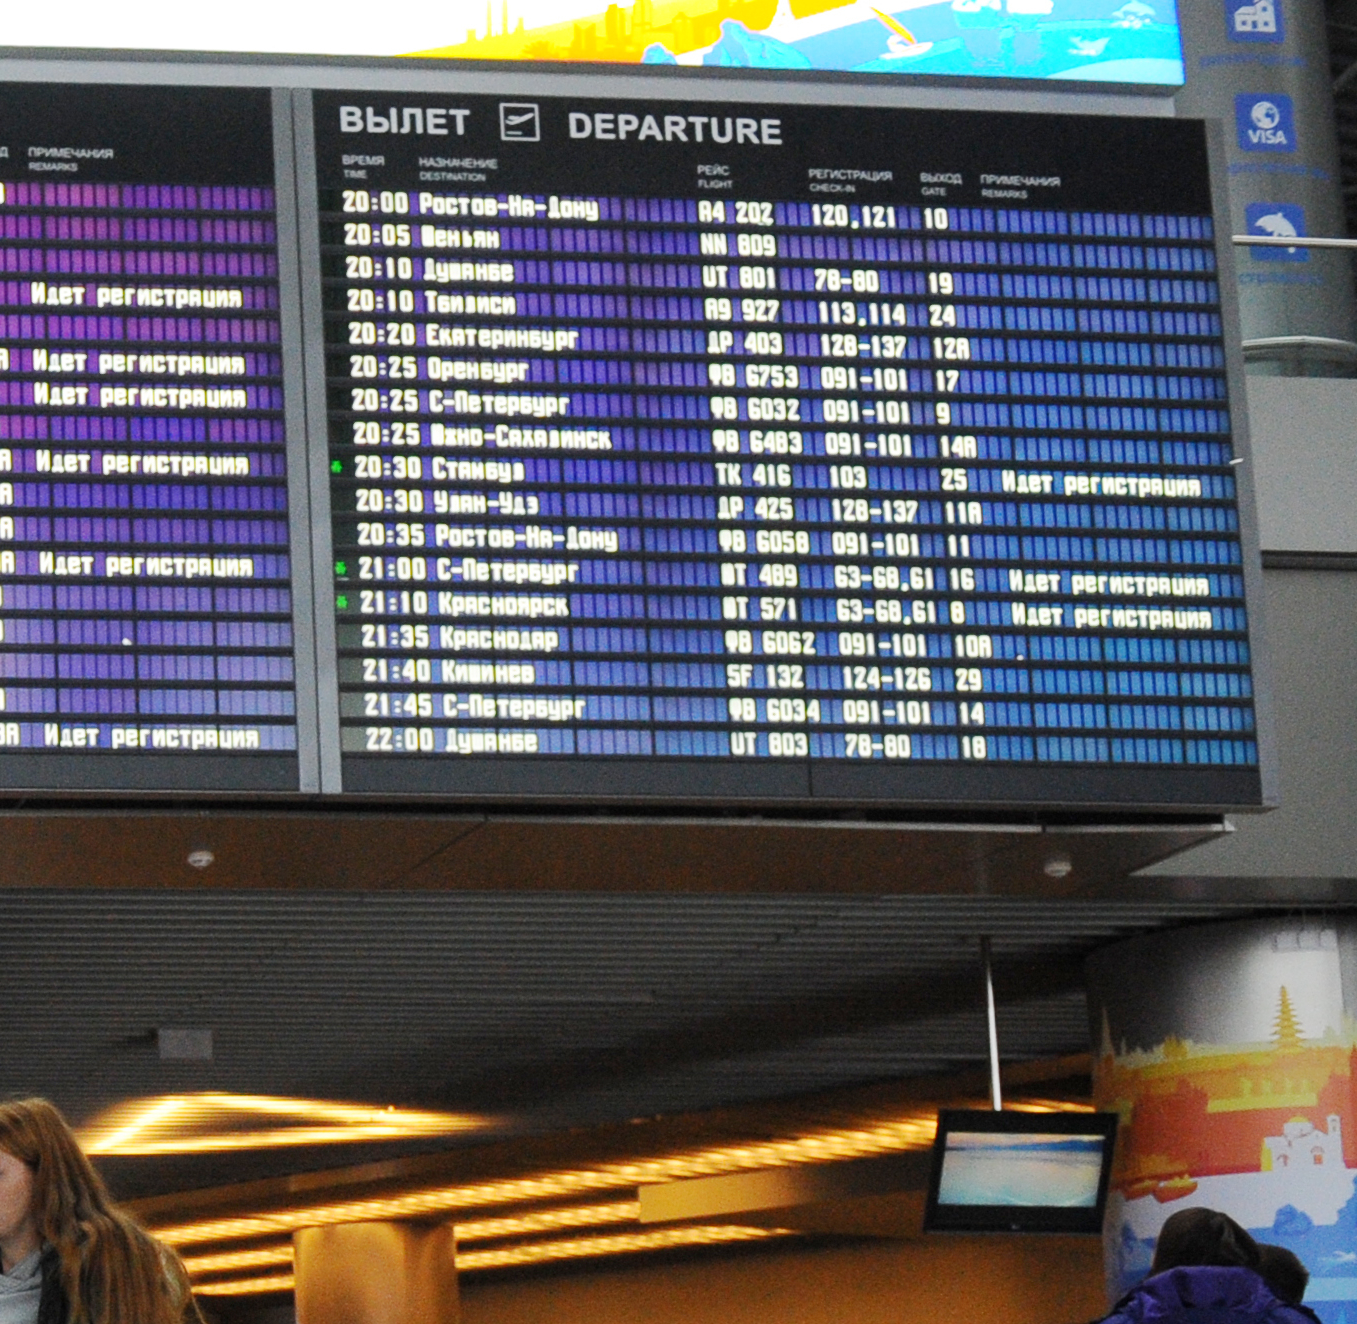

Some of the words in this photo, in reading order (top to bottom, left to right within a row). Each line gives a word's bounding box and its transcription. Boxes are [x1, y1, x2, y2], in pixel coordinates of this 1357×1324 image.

[339, 105, 470, 135] ВЫЛЕТ
[568, 112, 782, 145] DEPARTURE
[1248, 128, 1287, 145] VISA
[27, 146, 114, 159] ПРИМЕЧАНИЯ
[28, 161, 78, 172] REMARKS
[341, 154, 386, 166] ВРЕМЯ
[418, 156, 498, 170] НАЗНАЧЕНИЕ
[696, 164, 730, 178] РЕЙС
[808, 168, 893, 182] РЕГИСТРАЦИЯ
[919, 172, 963, 185] ВЫХОД
[980, 174, 1061, 187] ПРИМЕЧАНИЯ
[342, 190, 408, 214] 20:00
[419, 192, 599, 221] Ростов-На-Дону
[735, 201, 774, 226] 202
[924, 208, 948, 229] 10
[34, 382, 88, 406] Идет
[100, 387, 246, 409] регистрация
[354, 455, 421, 479] 20:30
[432, 456, 524, 483] Стамбул
[752, 464, 791, 487] 416
[830, 465, 866, 488] 103
[941, 468, 968, 491] 25
[1002, 470, 1053, 493] Идет
[1064, 475, 1201, 497] регистрация
[363, 658, 431, 682] 21:40
[441, 659, 535, 684] Кишинев
[767, 664, 804, 688] 132
[843, 666, 931, 690] 124-126
[956, 668, 982, 691] 29
